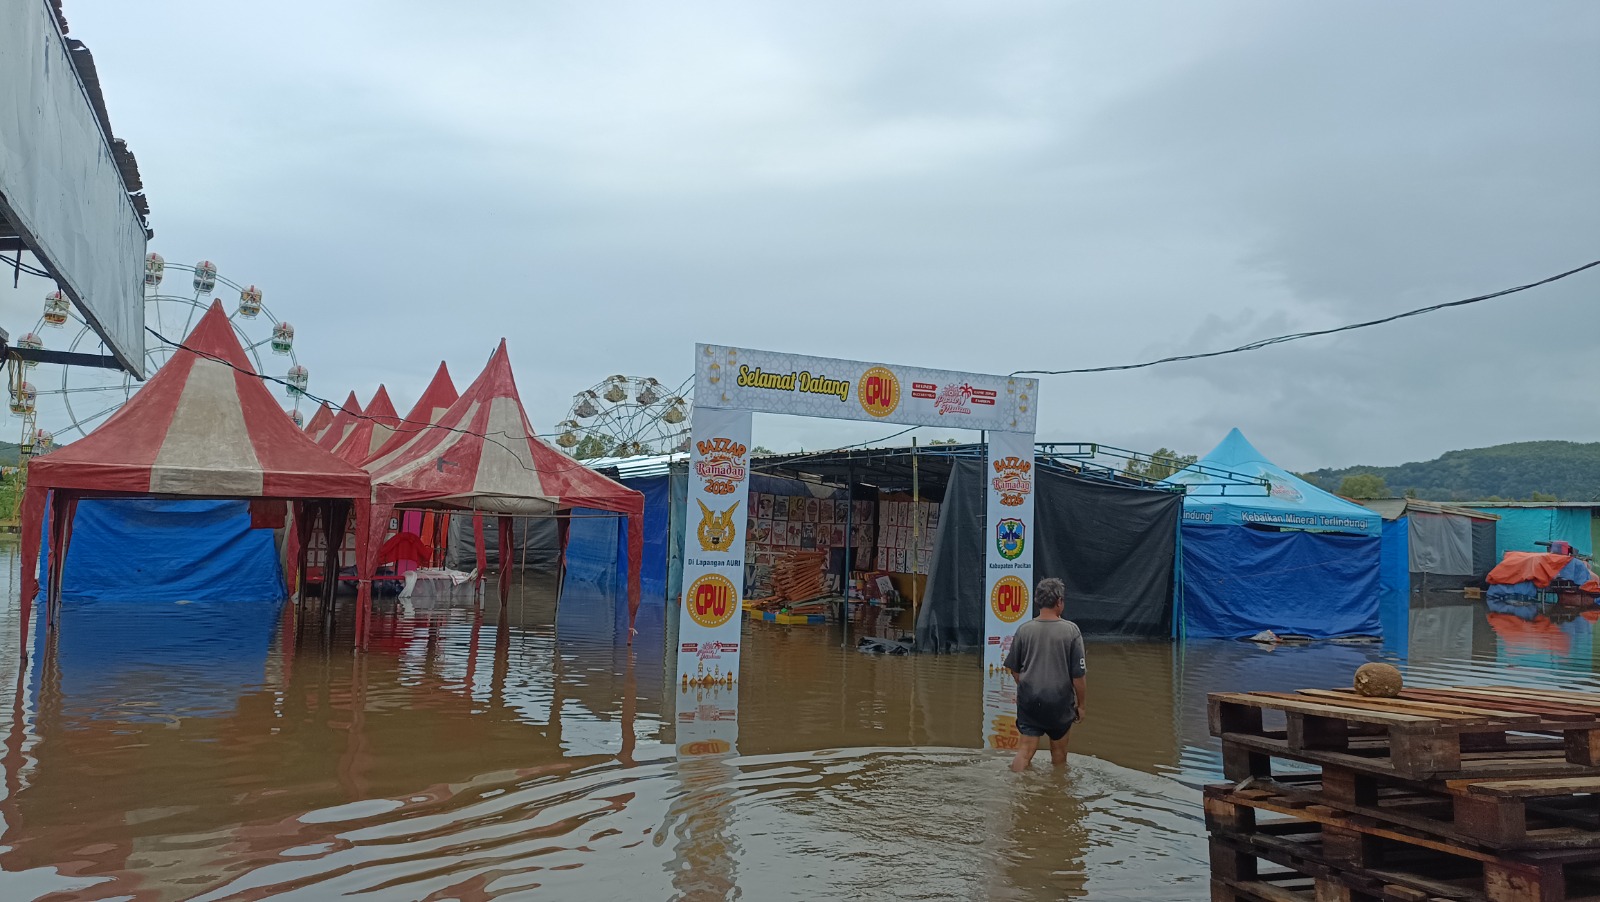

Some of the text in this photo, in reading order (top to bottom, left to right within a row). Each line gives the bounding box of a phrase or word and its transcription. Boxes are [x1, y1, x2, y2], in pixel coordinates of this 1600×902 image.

[737, 364, 850, 402] Selamat Datang
[865, 376, 892, 408] CPW
[696, 461, 745, 480] Ramadan
[704, 479, 735, 495] 2026
[992, 478, 1031, 493] Ramadan
[1000, 492, 1024, 507] 2026
[1241, 511, 1369, 530] Kebaikan Mineral Terlindungi
[688, 558, 741, 567] Di Lapangan AURI
[989, 562, 1014, 570] Kabupaten
[695, 583, 727, 617] CPW
[997, 584, 1022, 613] CPW
